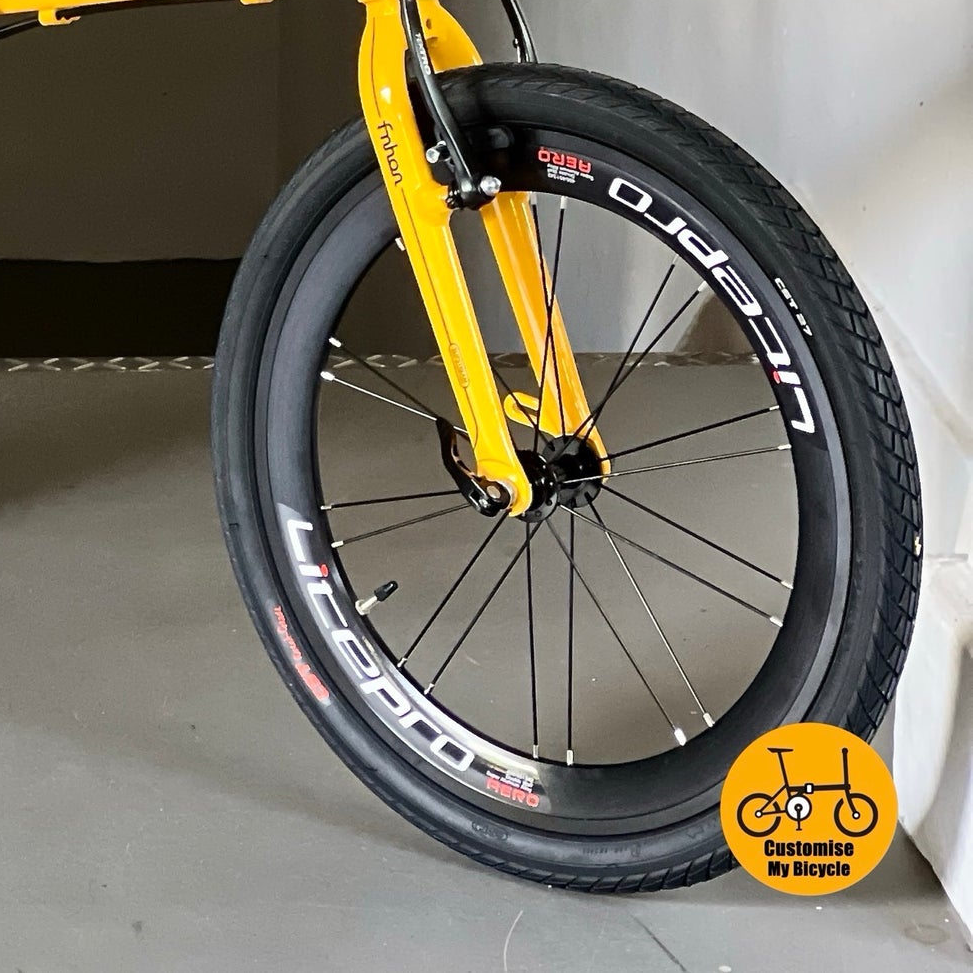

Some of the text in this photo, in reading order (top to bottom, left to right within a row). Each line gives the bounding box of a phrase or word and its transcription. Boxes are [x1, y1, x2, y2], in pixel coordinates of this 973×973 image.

[378, 120, 403, 185] fnhon
[538, 147, 592, 174] AERO
[608, 177, 815, 434] Litepro
[287, 519, 475, 772] Litepro
[486, 776, 539, 807] AERO
